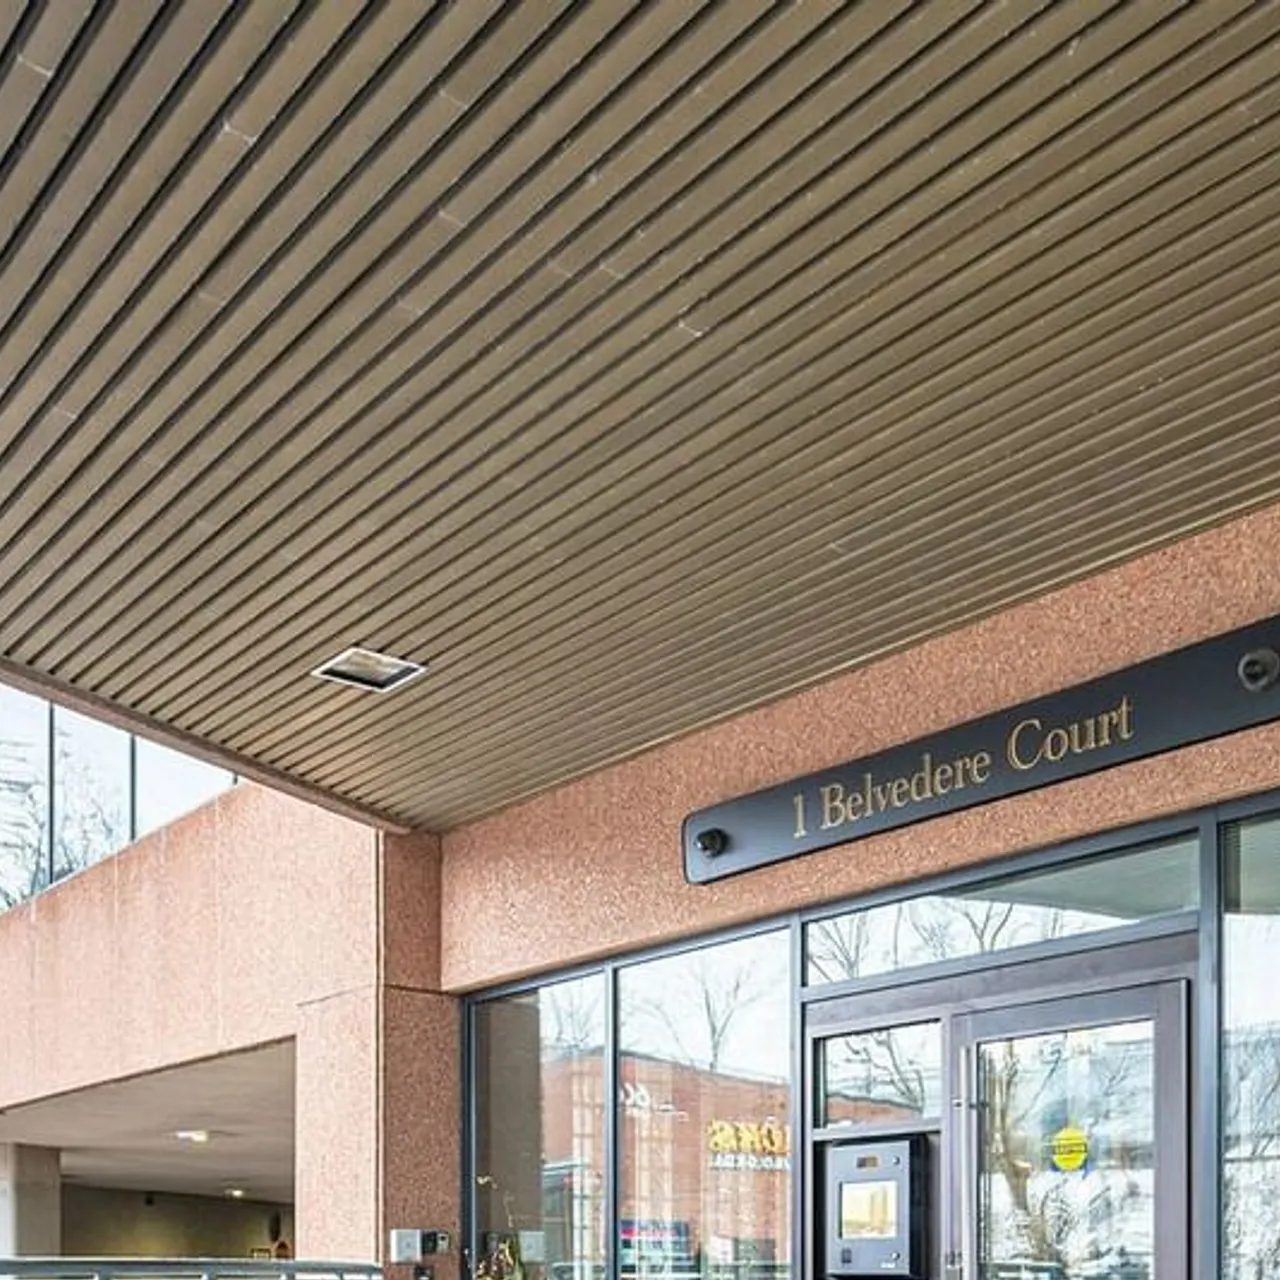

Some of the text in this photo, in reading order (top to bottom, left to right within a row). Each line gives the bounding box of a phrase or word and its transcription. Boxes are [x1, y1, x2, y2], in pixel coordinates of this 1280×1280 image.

[793, 694, 1134, 839] 1 Belvedere Court
